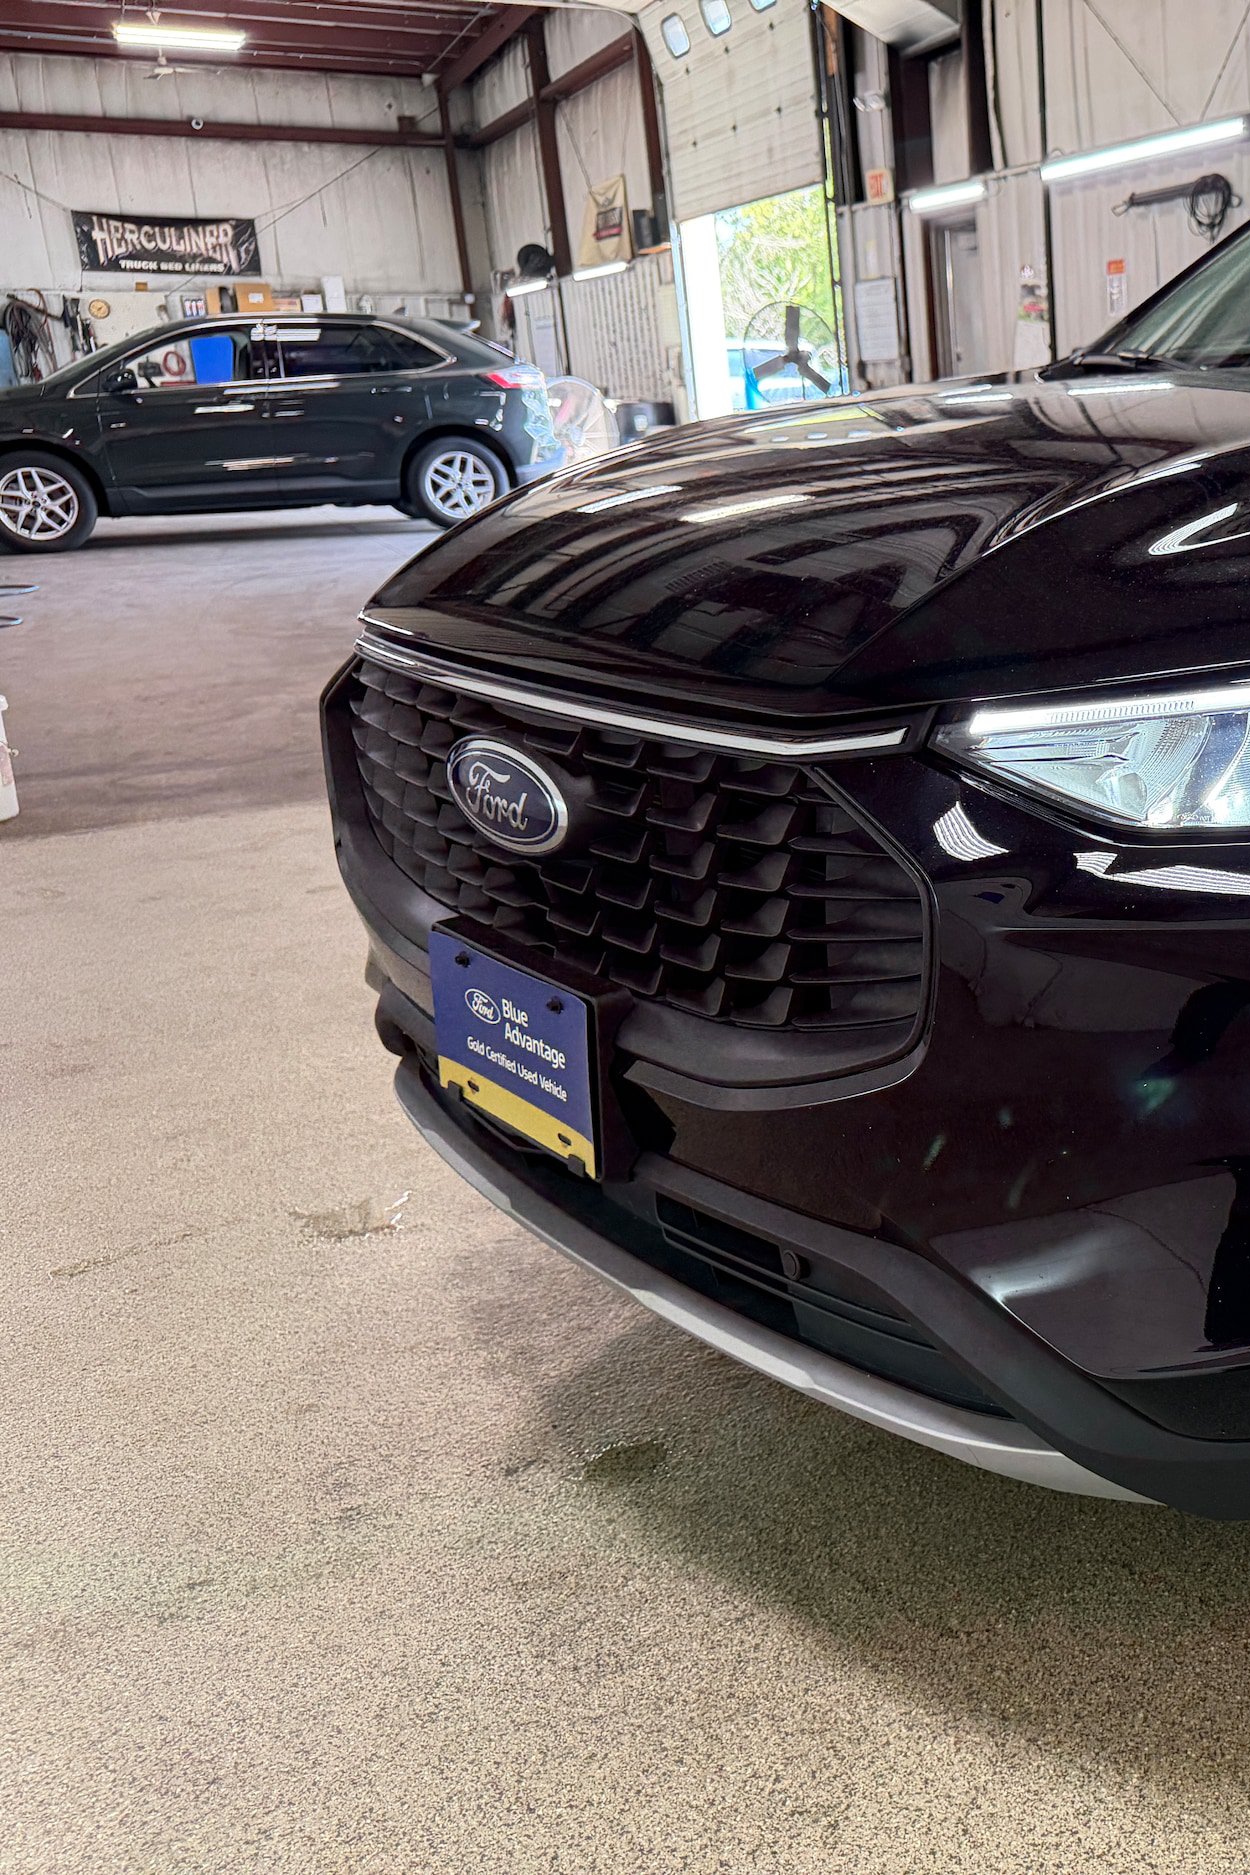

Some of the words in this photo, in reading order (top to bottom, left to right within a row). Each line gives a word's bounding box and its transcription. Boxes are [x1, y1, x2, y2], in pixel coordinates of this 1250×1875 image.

[91, 215, 241, 273] HERCULINER
[118, 259, 158, 270] TRUCK
[160, 261, 183, 272] BED
[466, 761, 528, 831] Ford
[472, 992, 494, 1020] Ford
[501, 998, 528, 1028] Blue
[467, 1036, 485, 1056] Gold
[485, 1045, 516, 1074] Certified
[517, 1062, 538, 1085] Used
[539, 1073, 568, 1102] Vehicle
[504, 1022, 566, 1069] Advantage
